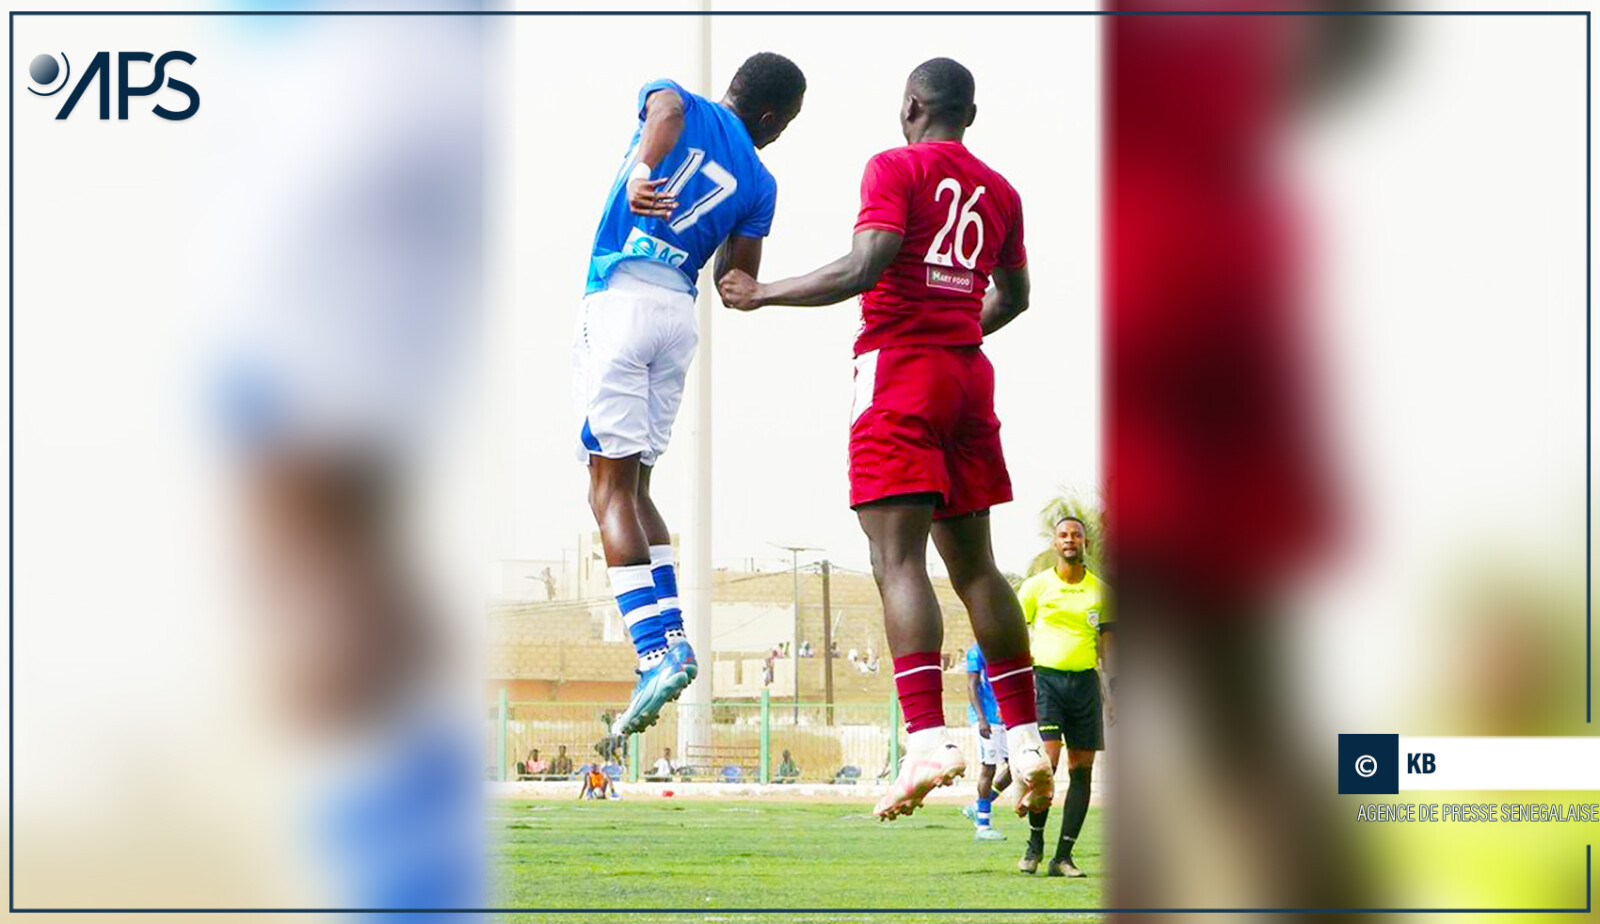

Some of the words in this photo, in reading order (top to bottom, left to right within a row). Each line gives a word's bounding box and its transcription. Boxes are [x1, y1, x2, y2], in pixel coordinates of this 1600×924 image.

[660, 147, 738, 234] 17
[923, 177, 986, 270] 26
[952, 276, 970, 286] FOOD
